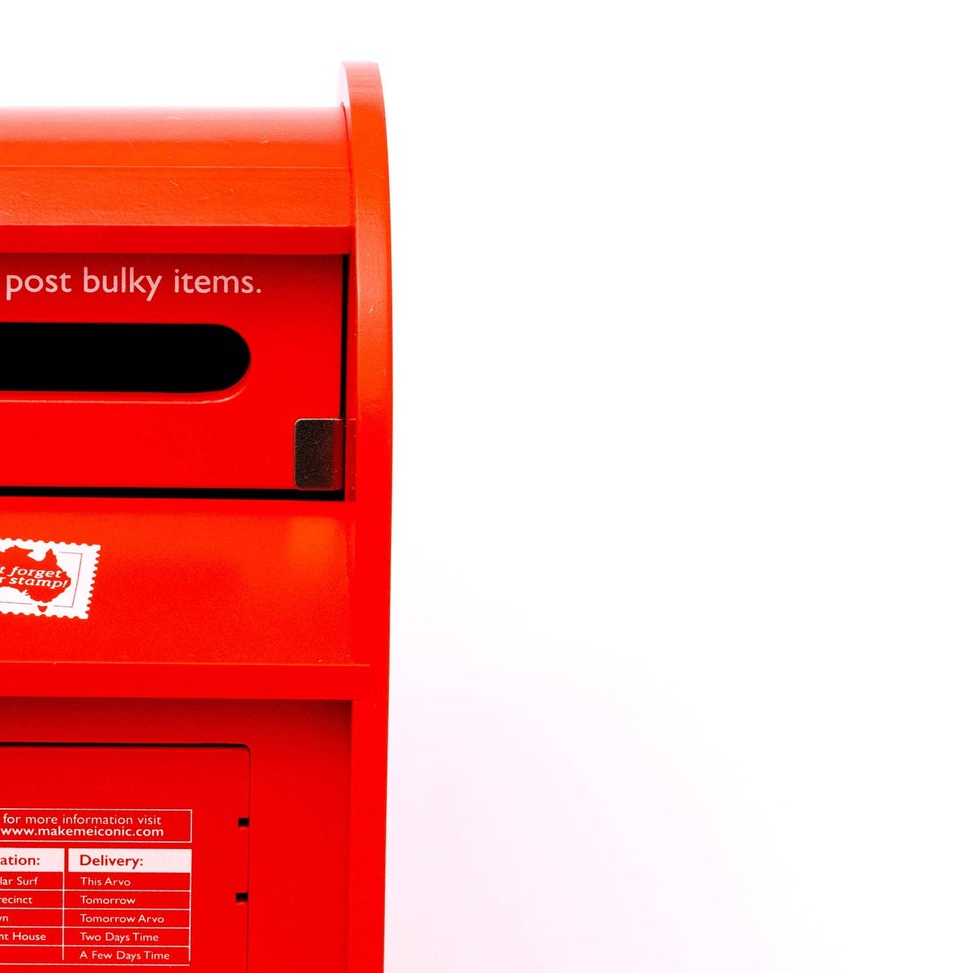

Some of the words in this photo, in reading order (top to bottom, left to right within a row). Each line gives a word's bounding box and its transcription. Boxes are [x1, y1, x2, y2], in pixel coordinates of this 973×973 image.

[6, 273, 71, 300] post
[84, 267, 162, 301] bulky
[175, 269, 261, 293] items.
[9, 565, 62, 579] forget
[9, 577, 68, 590] stamp!
[3, 813, 21, 825] for
[26, 816, 57, 825] more
[63, 813, 133, 825] information
[138, 814, 161, 825] visit
[1, 826, 163, 837] www.makemeiconic.com
[80, 854, 143, 869] Delivery:
[17, 877, 38, 886] Surf
[81, 877, 101, 886] This
[105, 877, 131, 886] Arvo
[80, 896, 136, 905] Tomorrow
[80, 914, 135, 923] Tomorrow
[138, 914, 164, 923] Arvo
[13, 932, 46, 941] House
[80, 932, 101, 941] Two
[106, 932, 130, 943] Days
[133, 932, 159, 941] Time
[80, 951, 88, 960] A
[92, 951, 111, 960] Few
[115, 951, 141, 963] Days
[144, 951, 170, 960] Time
